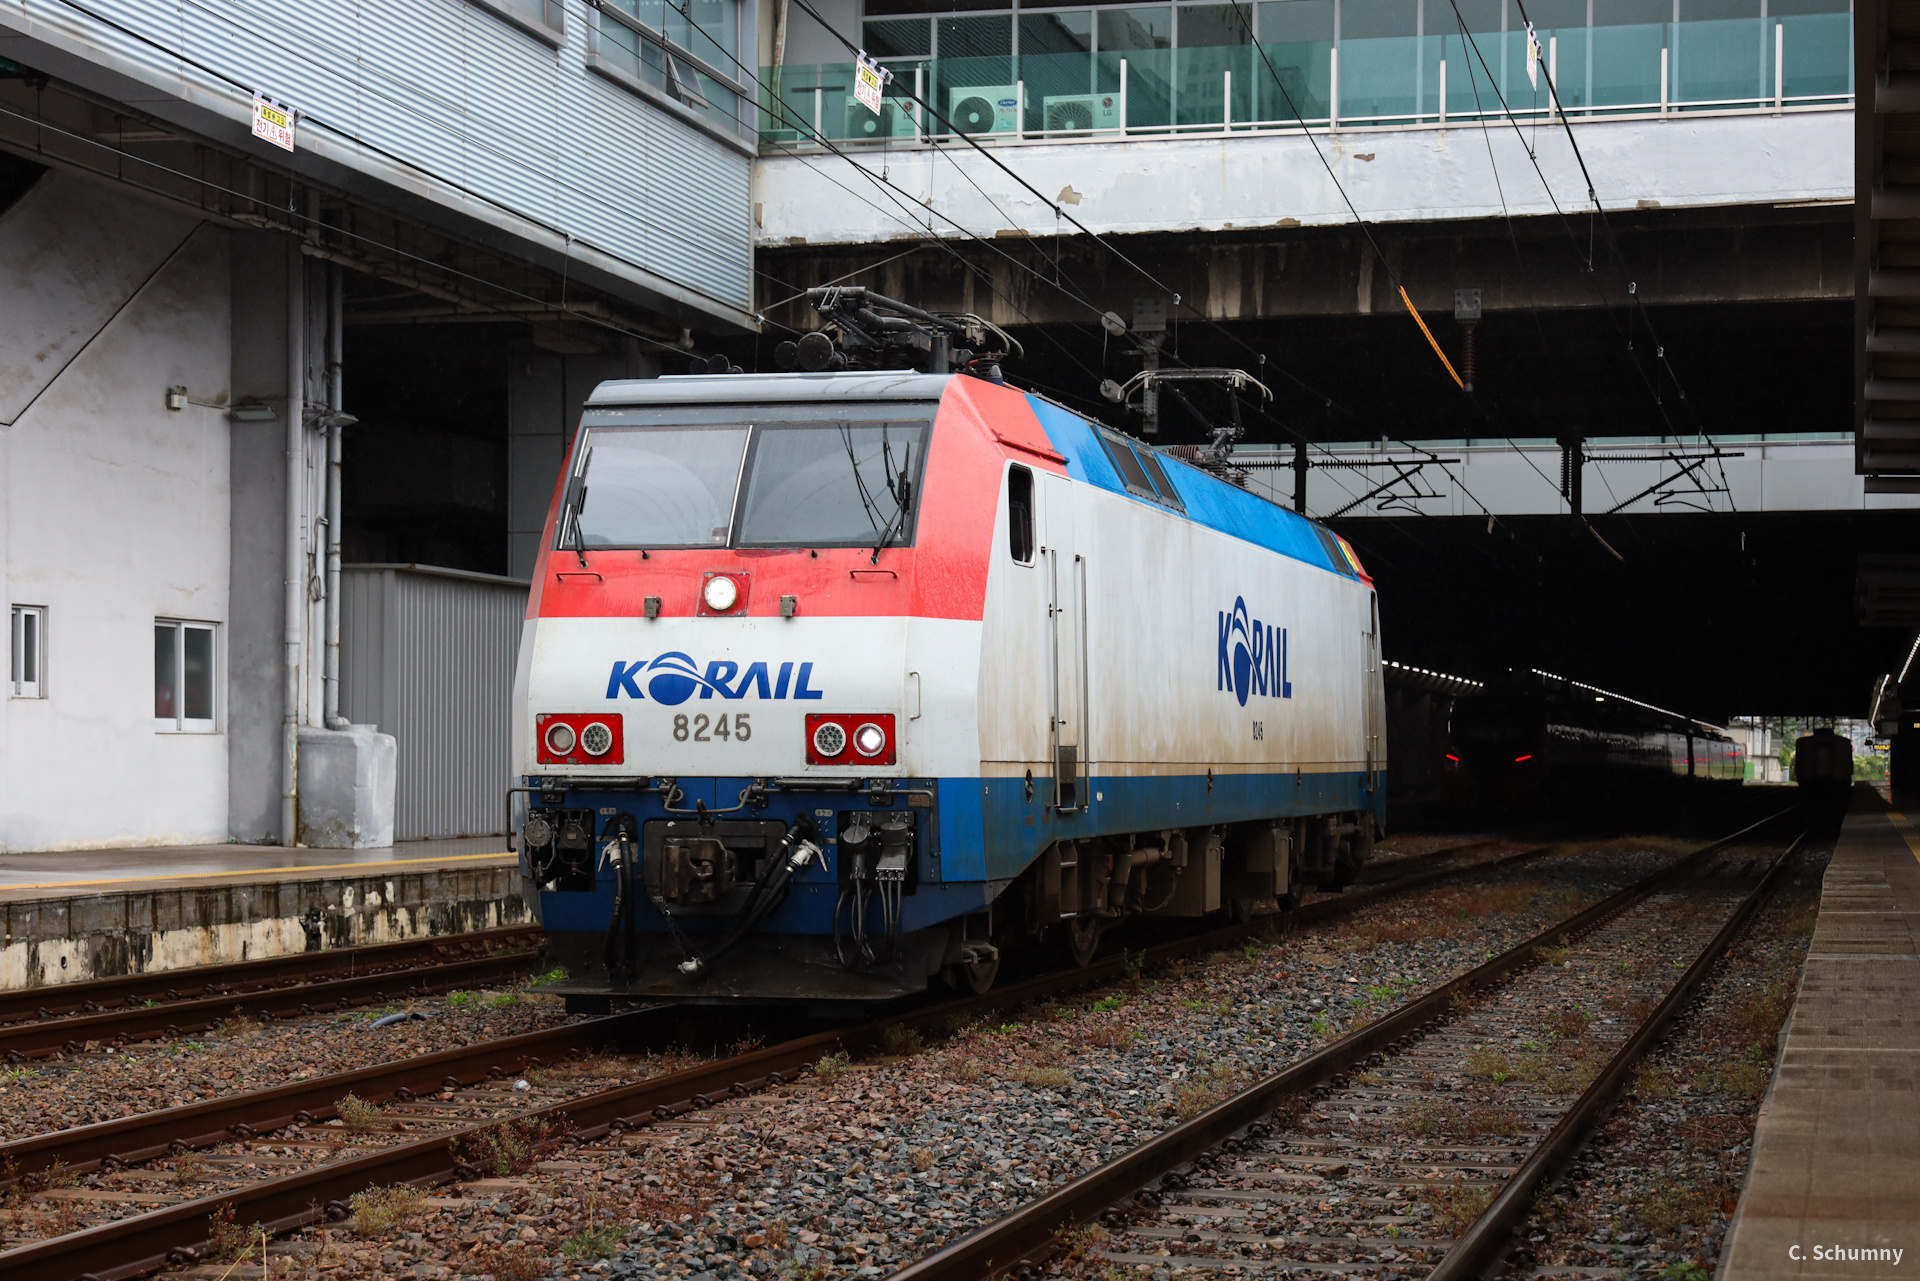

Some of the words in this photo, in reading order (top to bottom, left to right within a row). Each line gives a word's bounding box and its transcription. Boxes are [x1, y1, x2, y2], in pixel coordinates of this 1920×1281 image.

[256, 118, 270, 136] 전기
[279, 129, 291, 146] 위험
[1218, 595, 1292, 708] KORAIL
[606, 652, 823, 706] KORAIL
[673, 713, 751, 742] 8245
